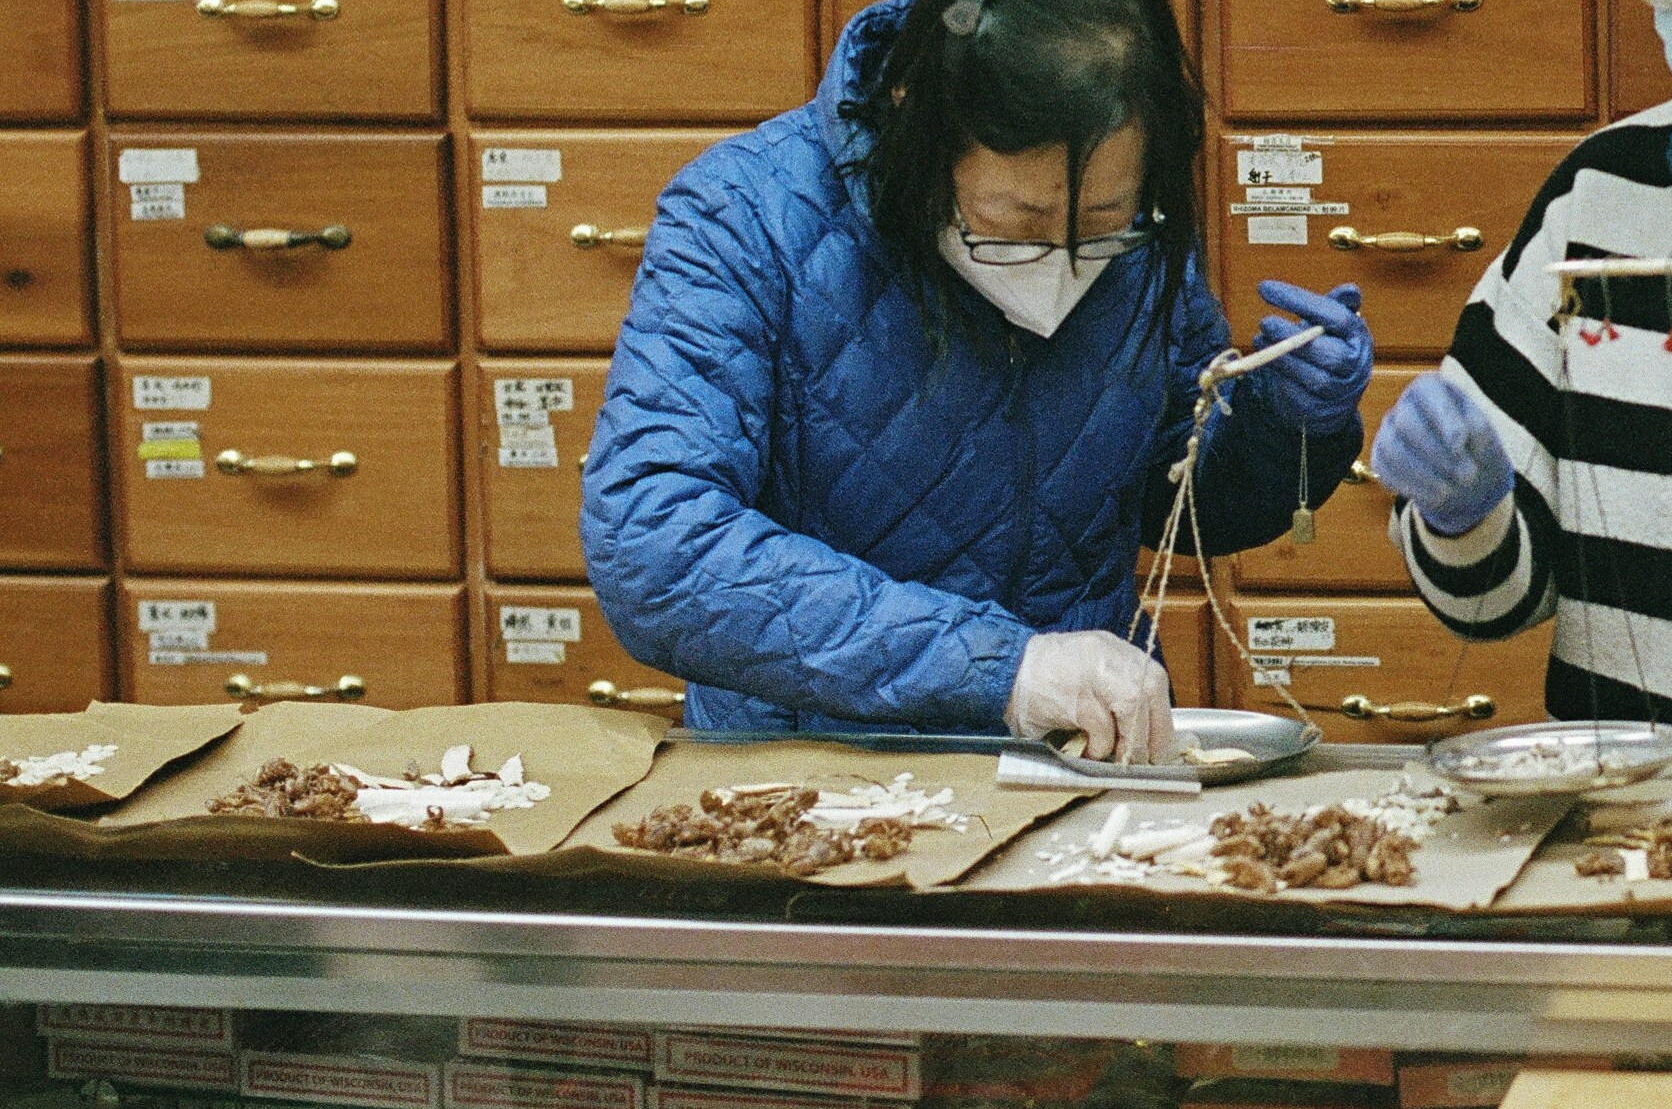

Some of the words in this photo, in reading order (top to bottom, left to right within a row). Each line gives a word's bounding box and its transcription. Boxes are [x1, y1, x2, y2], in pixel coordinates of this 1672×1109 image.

[256, 1067, 304, 1084] PRODUCT
[310, 1071, 325, 1086] OF
[682, 1049, 752, 1072] PRODUCT
[755, 1056, 774, 1072] OF
[859, 1065, 891, 1081] USA
